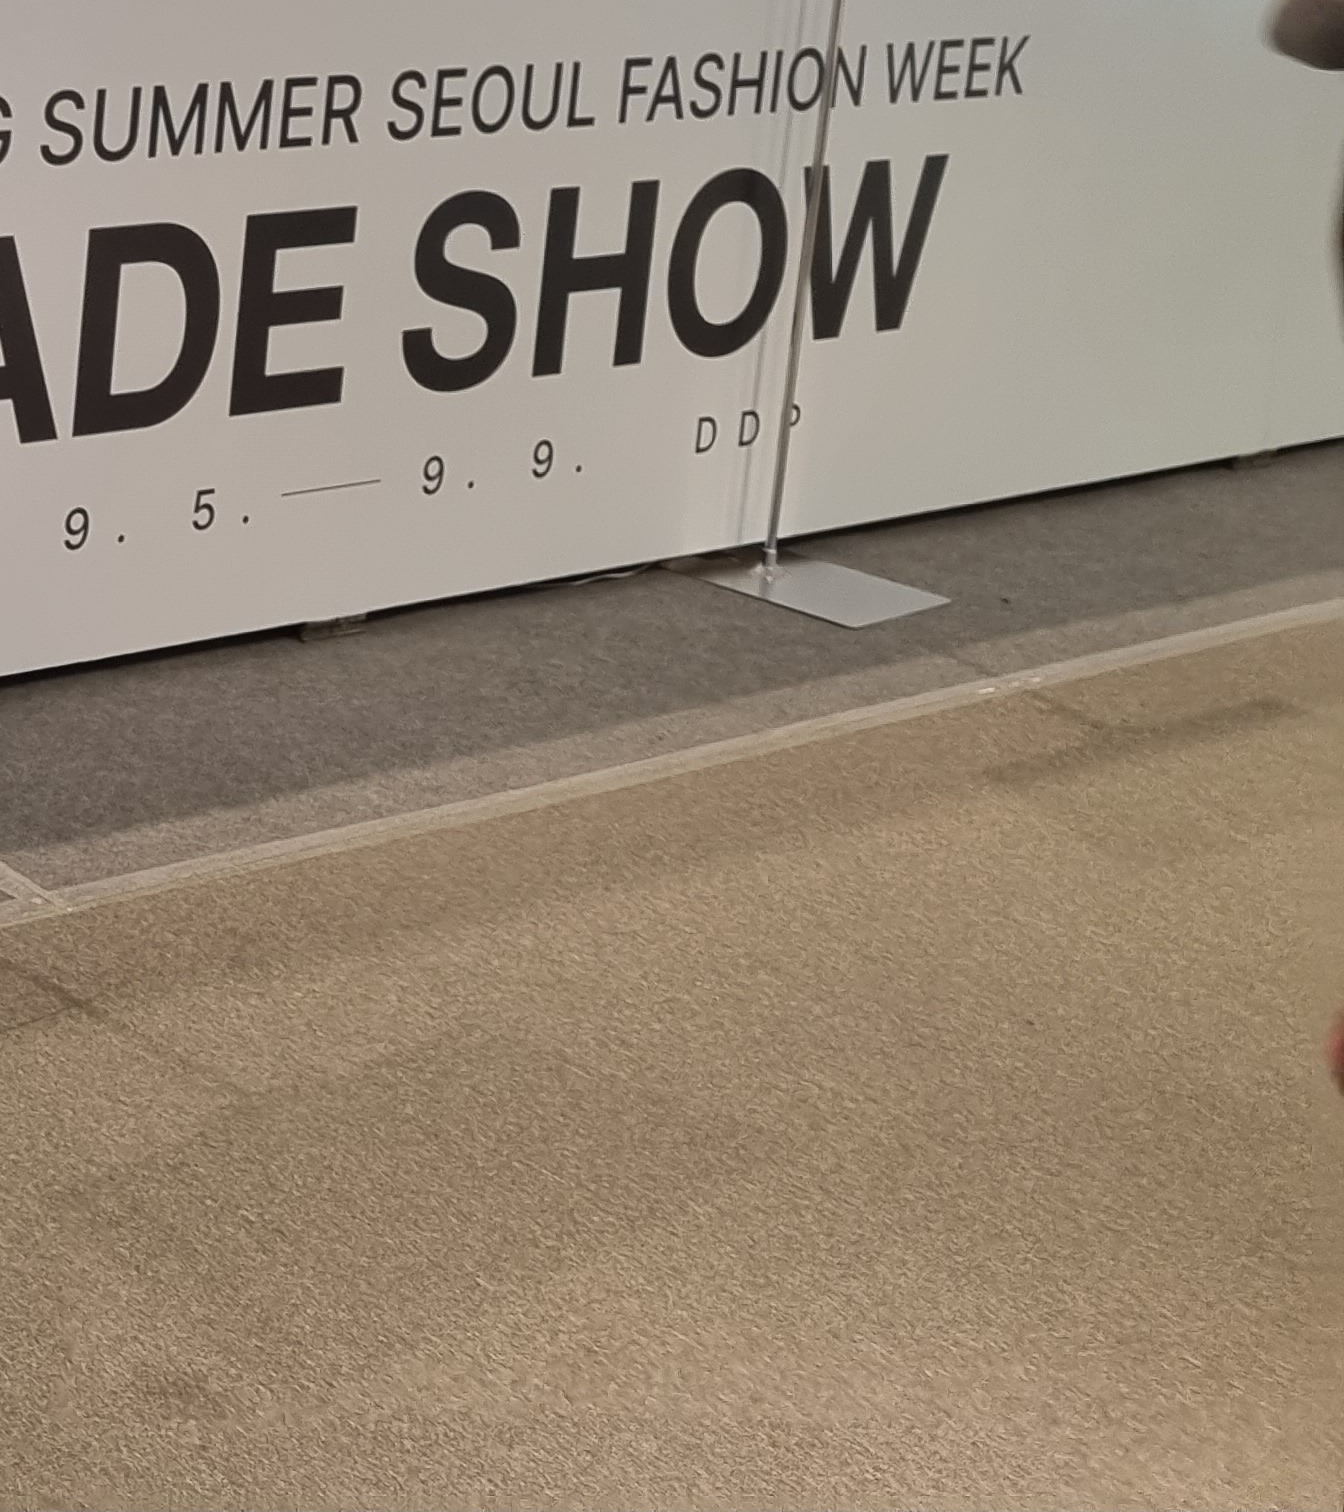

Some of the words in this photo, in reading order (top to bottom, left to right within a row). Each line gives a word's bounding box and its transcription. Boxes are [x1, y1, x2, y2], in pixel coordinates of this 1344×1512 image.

[40, 73, 360, 167] SUMMER
[387, 60, 596, 141] SEOUL
[618, 43, 867, 123] FASHION
[886, 35, 1030, 105] WEEK
[401, 153, 949, 393] SHOW
